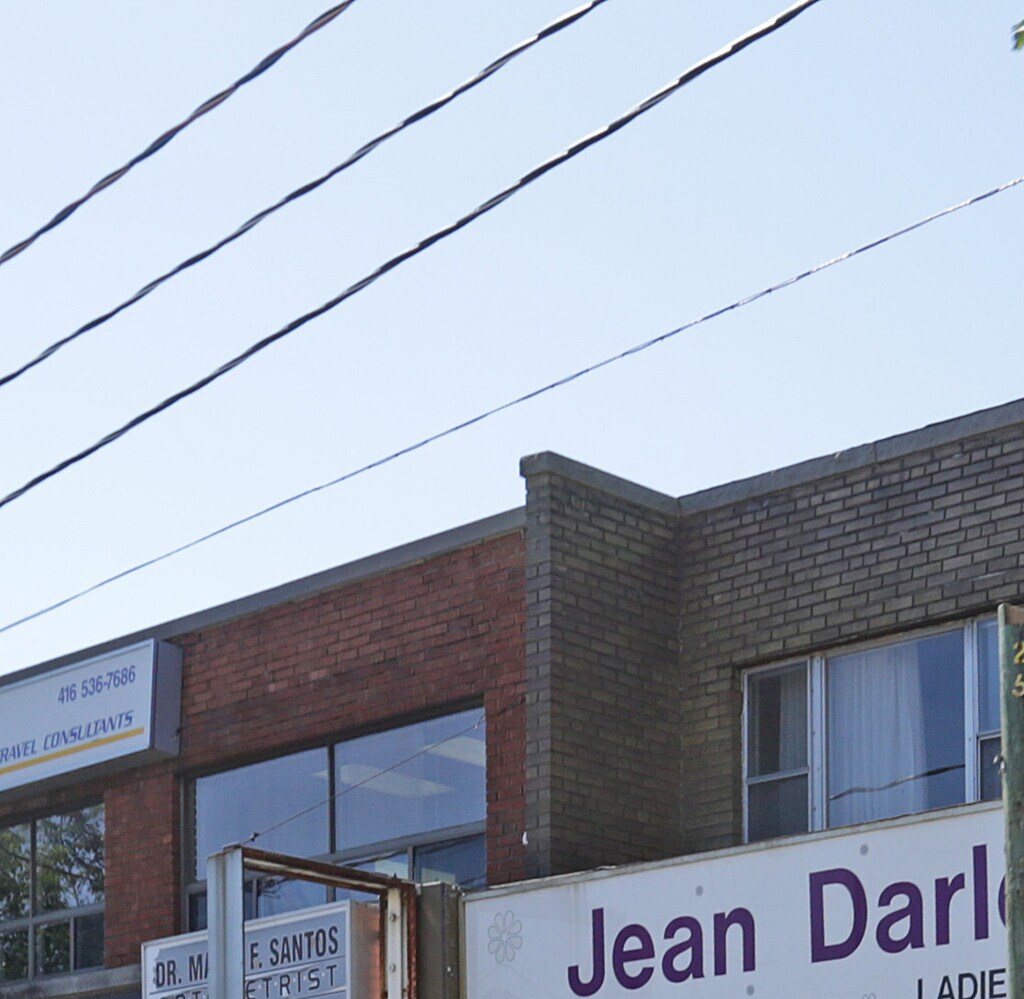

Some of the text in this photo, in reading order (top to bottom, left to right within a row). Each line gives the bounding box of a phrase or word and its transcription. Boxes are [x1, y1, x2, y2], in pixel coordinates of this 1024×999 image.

[58, 665, 136, 704] 416 536-7686
[0, 710, 134, 764] RAVEL CONSULTANTS
[156, 958, 182, 988] DR.
[270, 926, 339, 967] SANTOS
[567, 907, 756, 997] Jean
